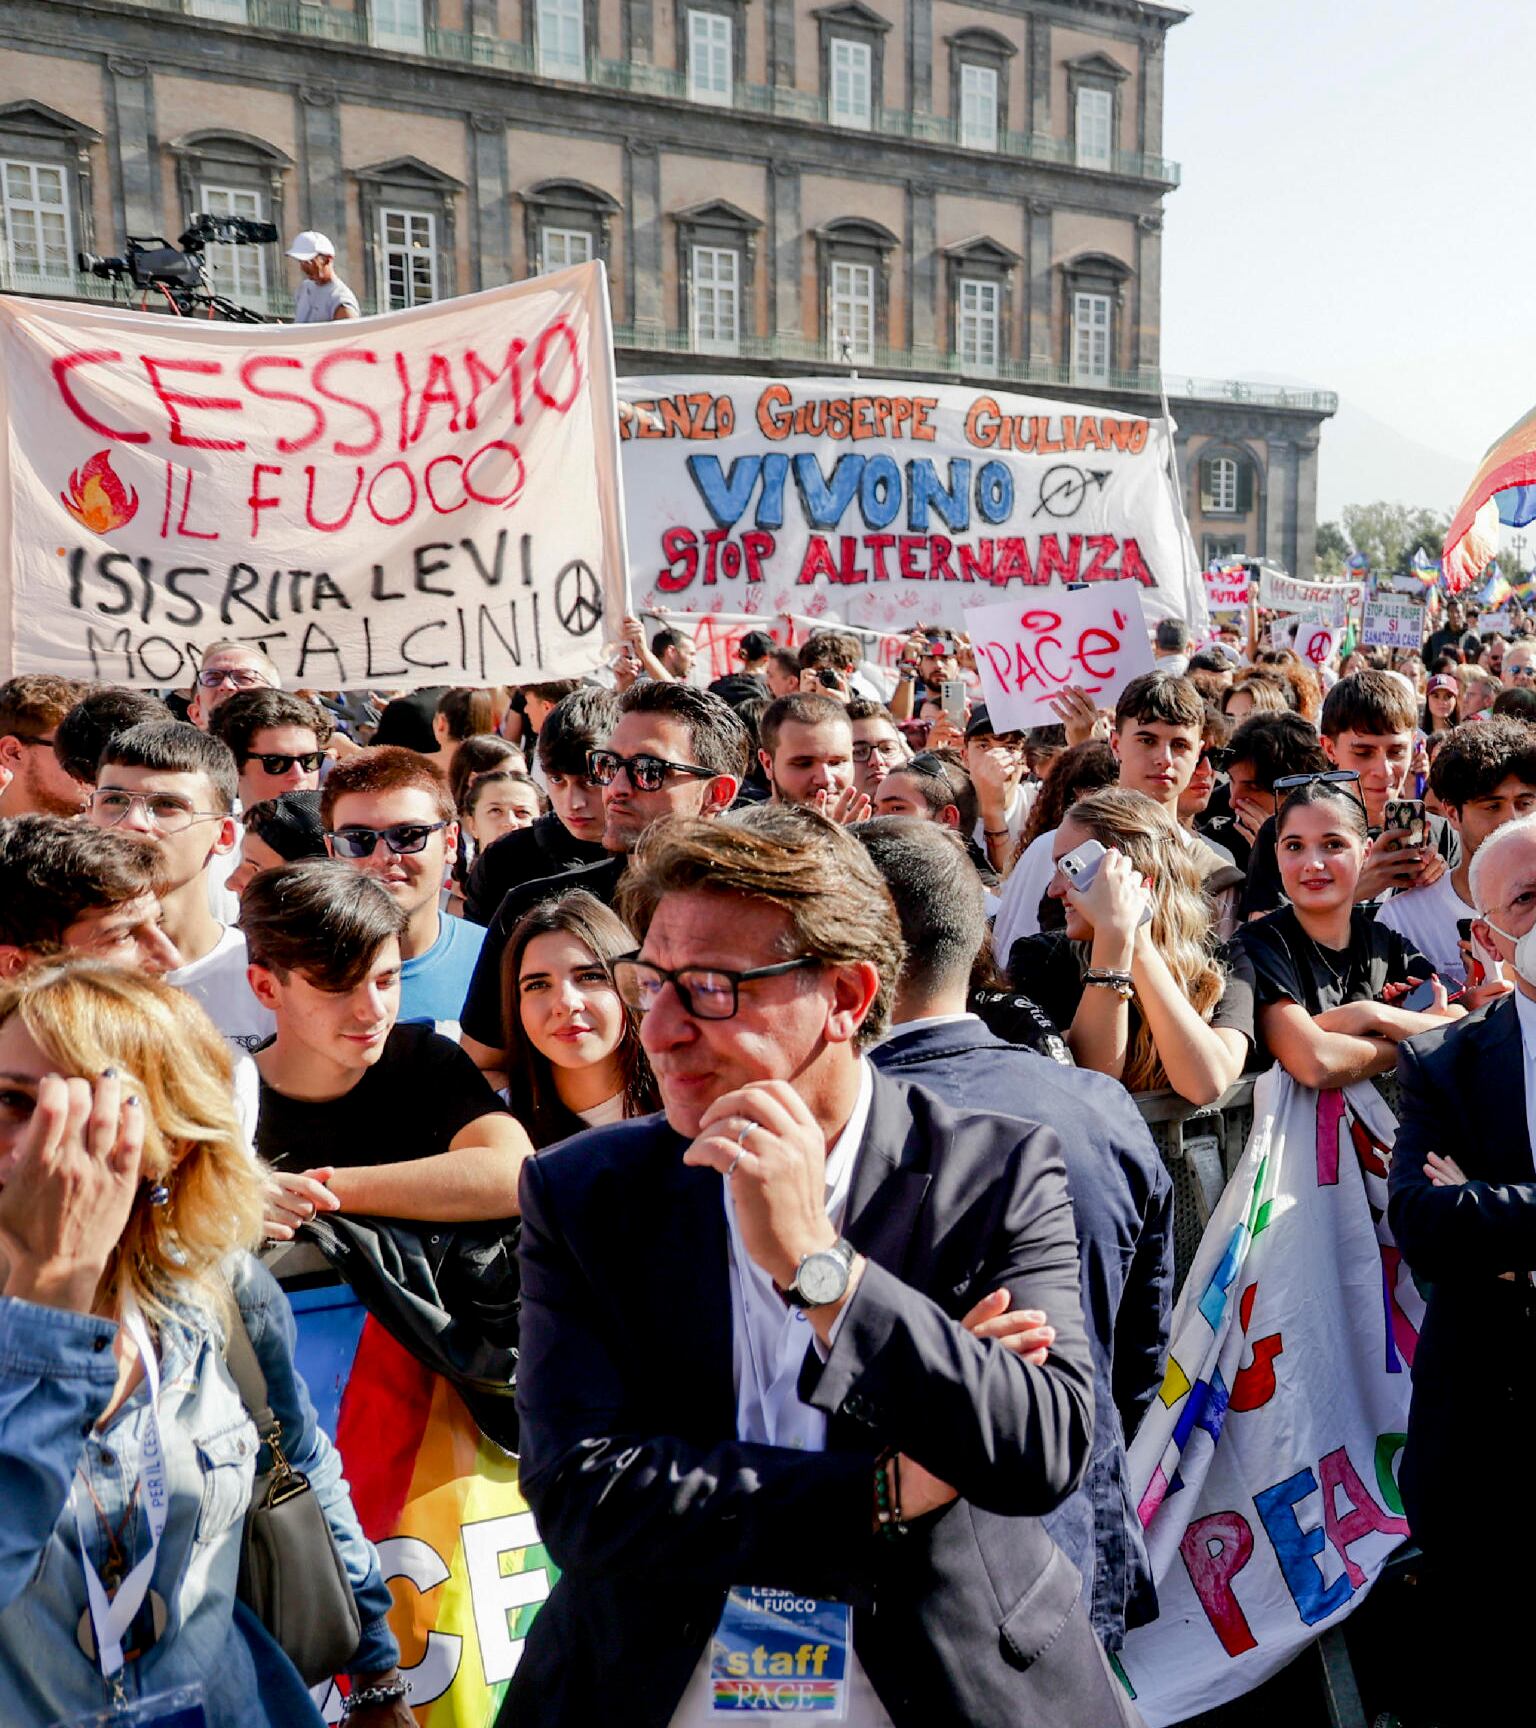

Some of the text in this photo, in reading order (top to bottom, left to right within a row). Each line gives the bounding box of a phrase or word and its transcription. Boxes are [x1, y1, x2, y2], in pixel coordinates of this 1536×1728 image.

[52, 313, 583, 456] CESSIAMO
[756, 384, 939, 442] GIUSEPPE
[964, 396, 1149, 454] GIULIANO
[160, 440, 525, 540] IL FUOCO
[687, 453, 1015, 533] VIVONO
[68, 529, 532, 626] ISIS RITA LEVI
[655, 526, 1158, 593] STOP ALTERNANZA
[763, 1598, 816, 1613] FUOCO
[726, 1645, 831, 1676] staff
[734, 1681, 816, 1710] PACE
